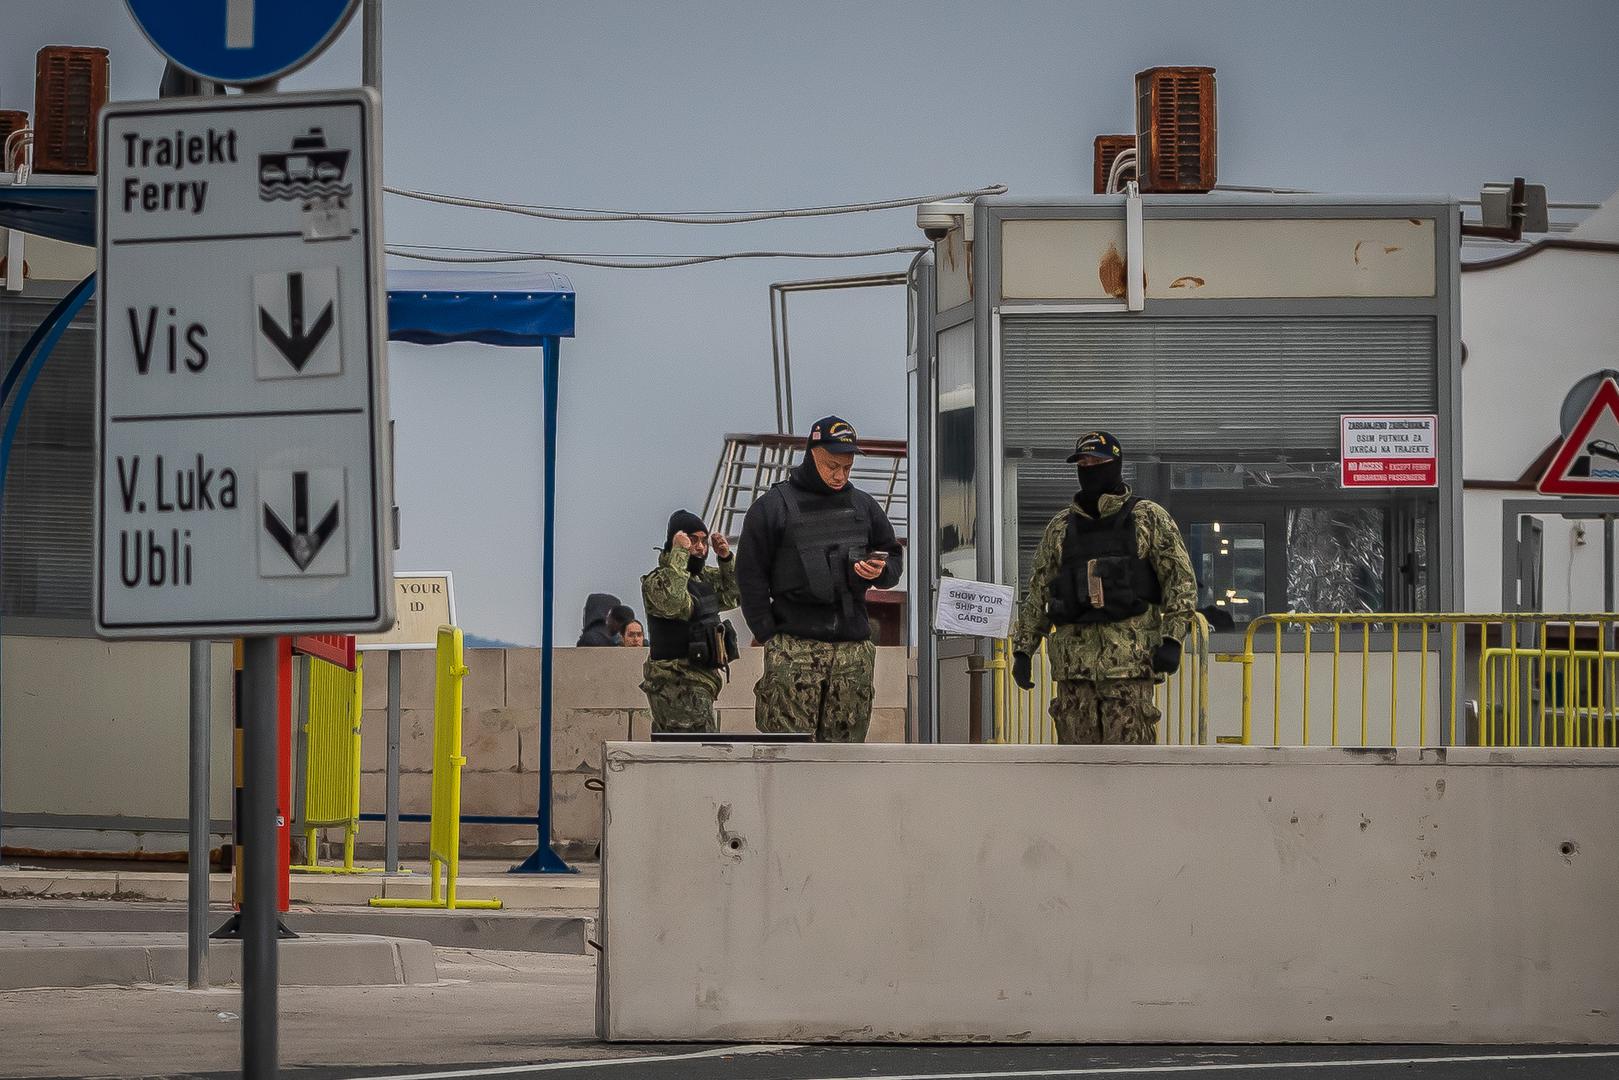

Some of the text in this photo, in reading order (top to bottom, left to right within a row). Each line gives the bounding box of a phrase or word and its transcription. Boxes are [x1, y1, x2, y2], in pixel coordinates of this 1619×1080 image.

[122, 128, 238, 170] Trajekt
[123, 177, 209, 214] Ferry
[127, 305, 209, 375] Vis
[1357, 434, 1422, 442] OSIM PUTNIKA ZA
[119, 528, 193, 588] Ubli
[400, 583, 442, 594] YOUR
[949, 590, 1003, 605] SHOW YOUR
[410, 602, 424, 612] ID
[955, 602, 994, 615] SHIP'S ID
[957, 613, 989, 624] CARDS
